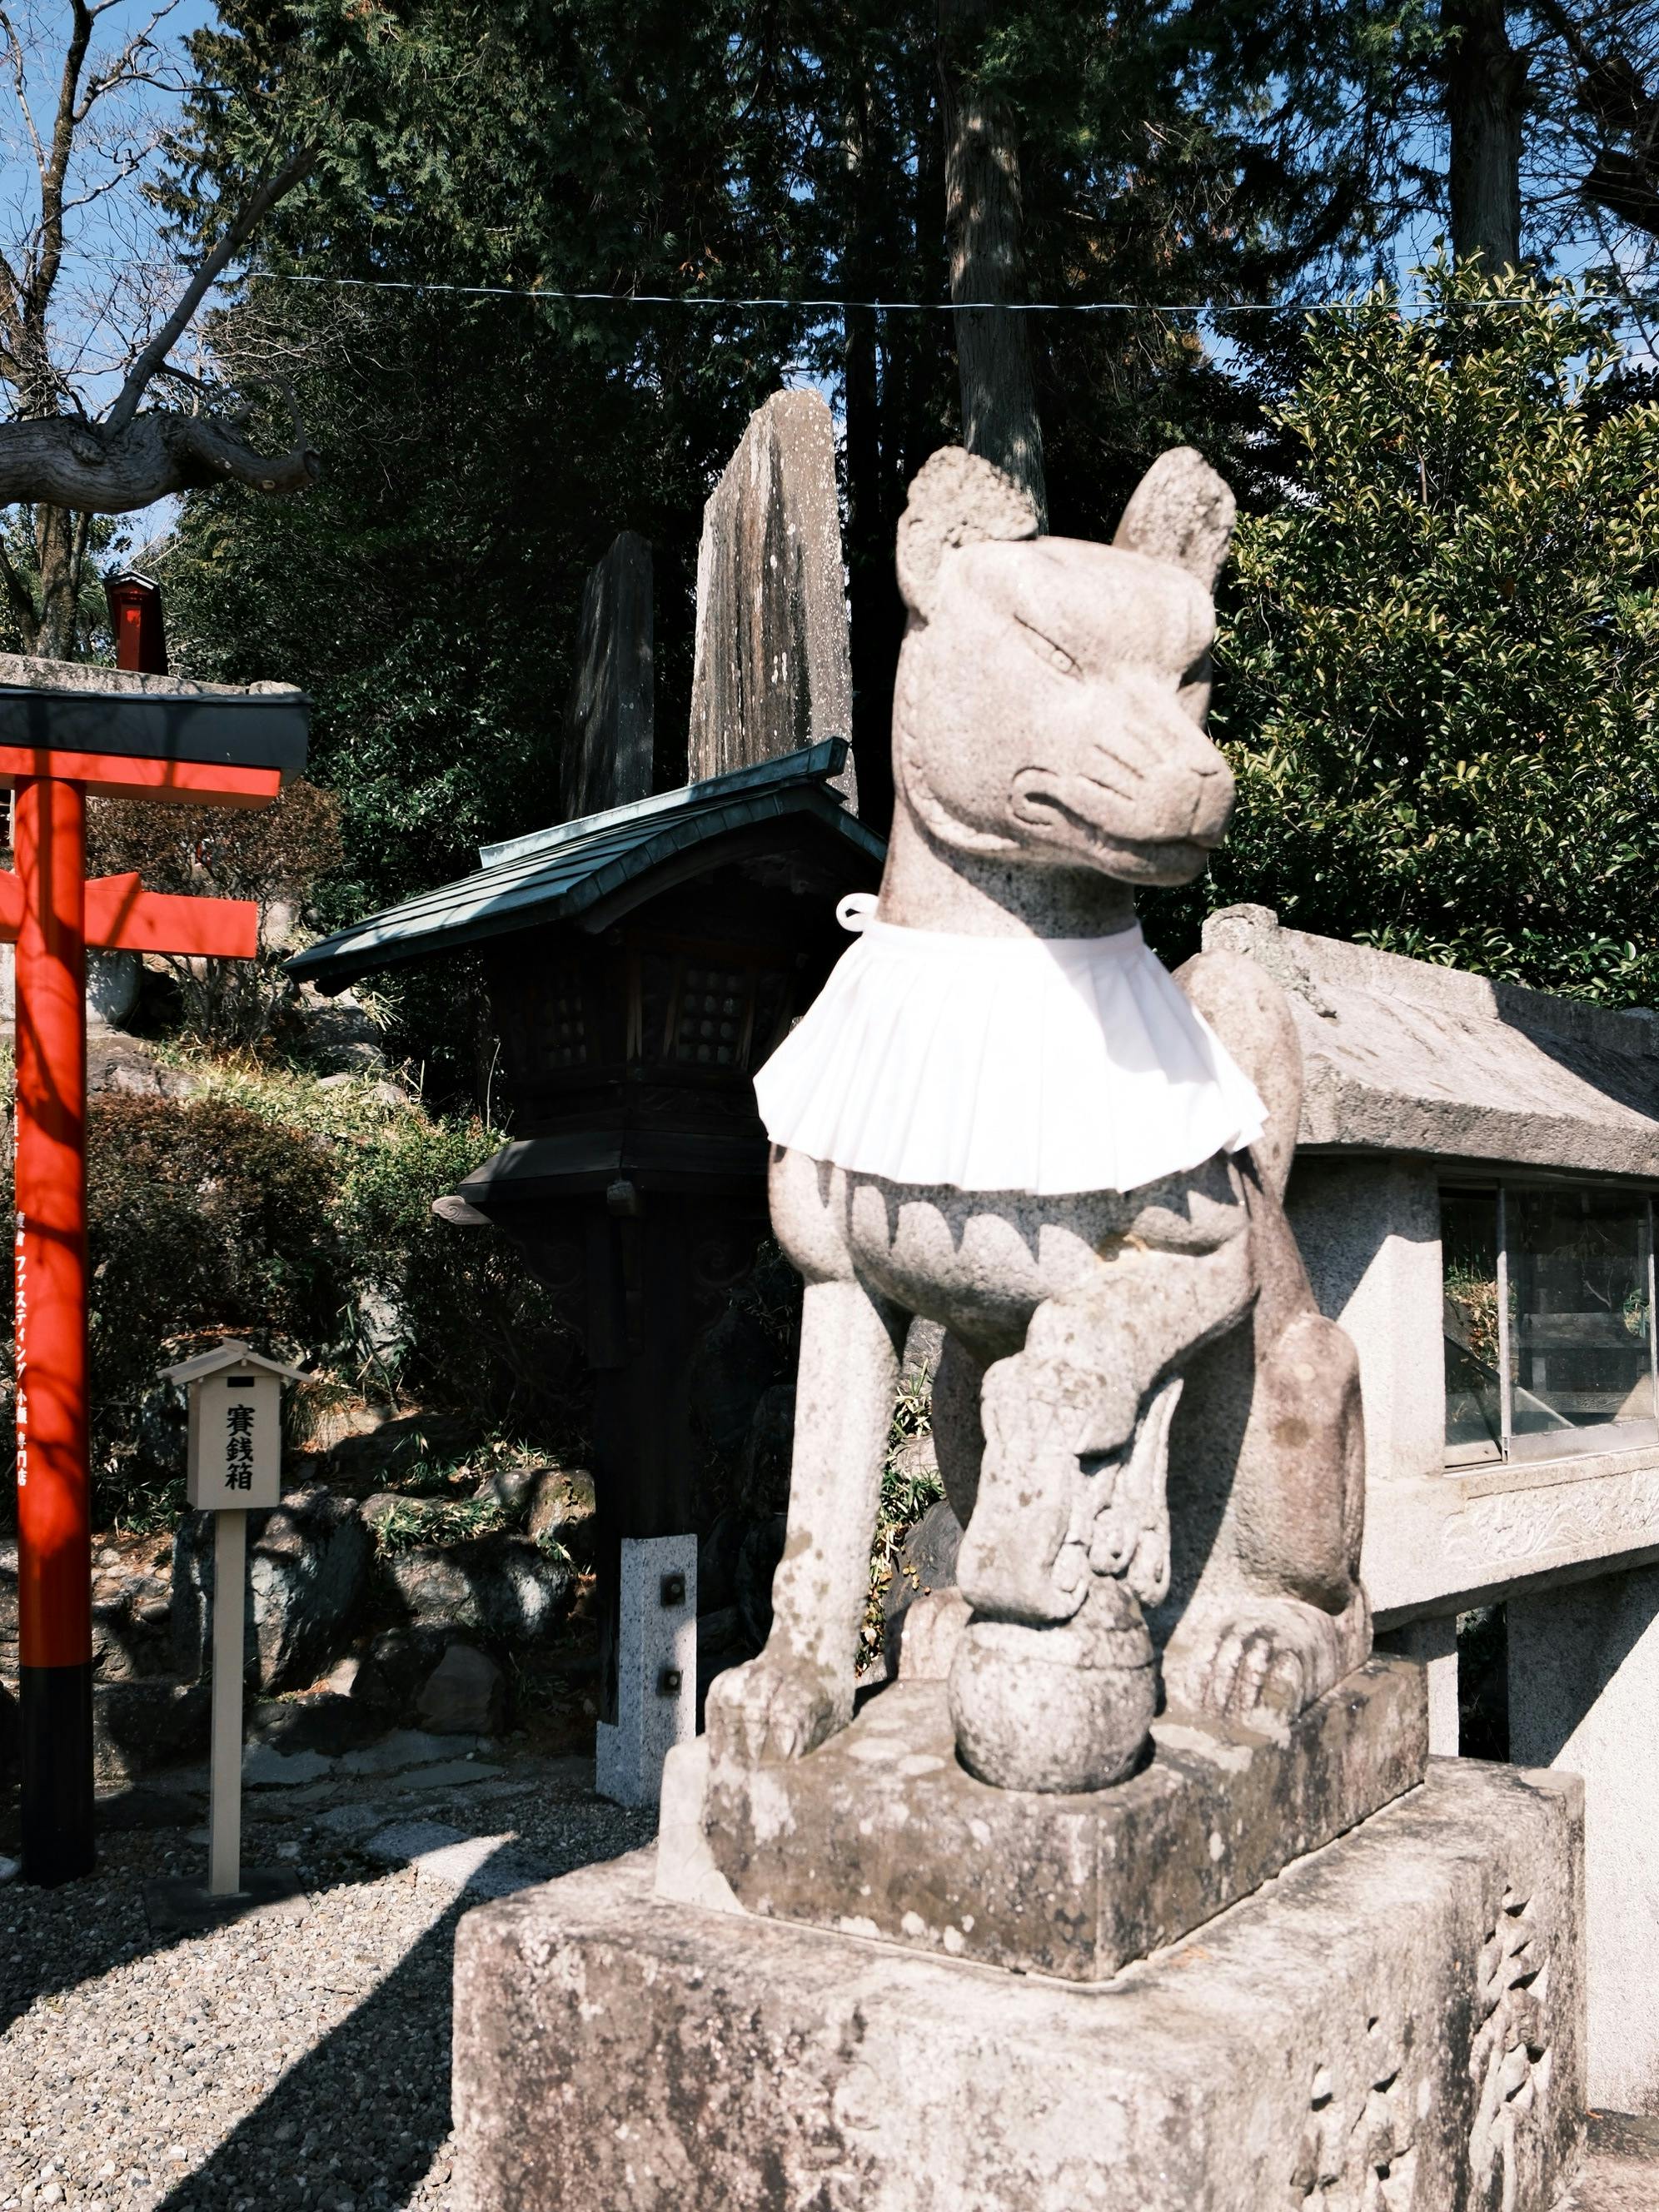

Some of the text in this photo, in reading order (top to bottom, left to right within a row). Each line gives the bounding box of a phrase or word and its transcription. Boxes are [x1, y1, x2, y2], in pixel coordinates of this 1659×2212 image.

[15, 1255, 27, 1379] ファスティング
[224, 1404, 256, 1491] 賽銭箱
